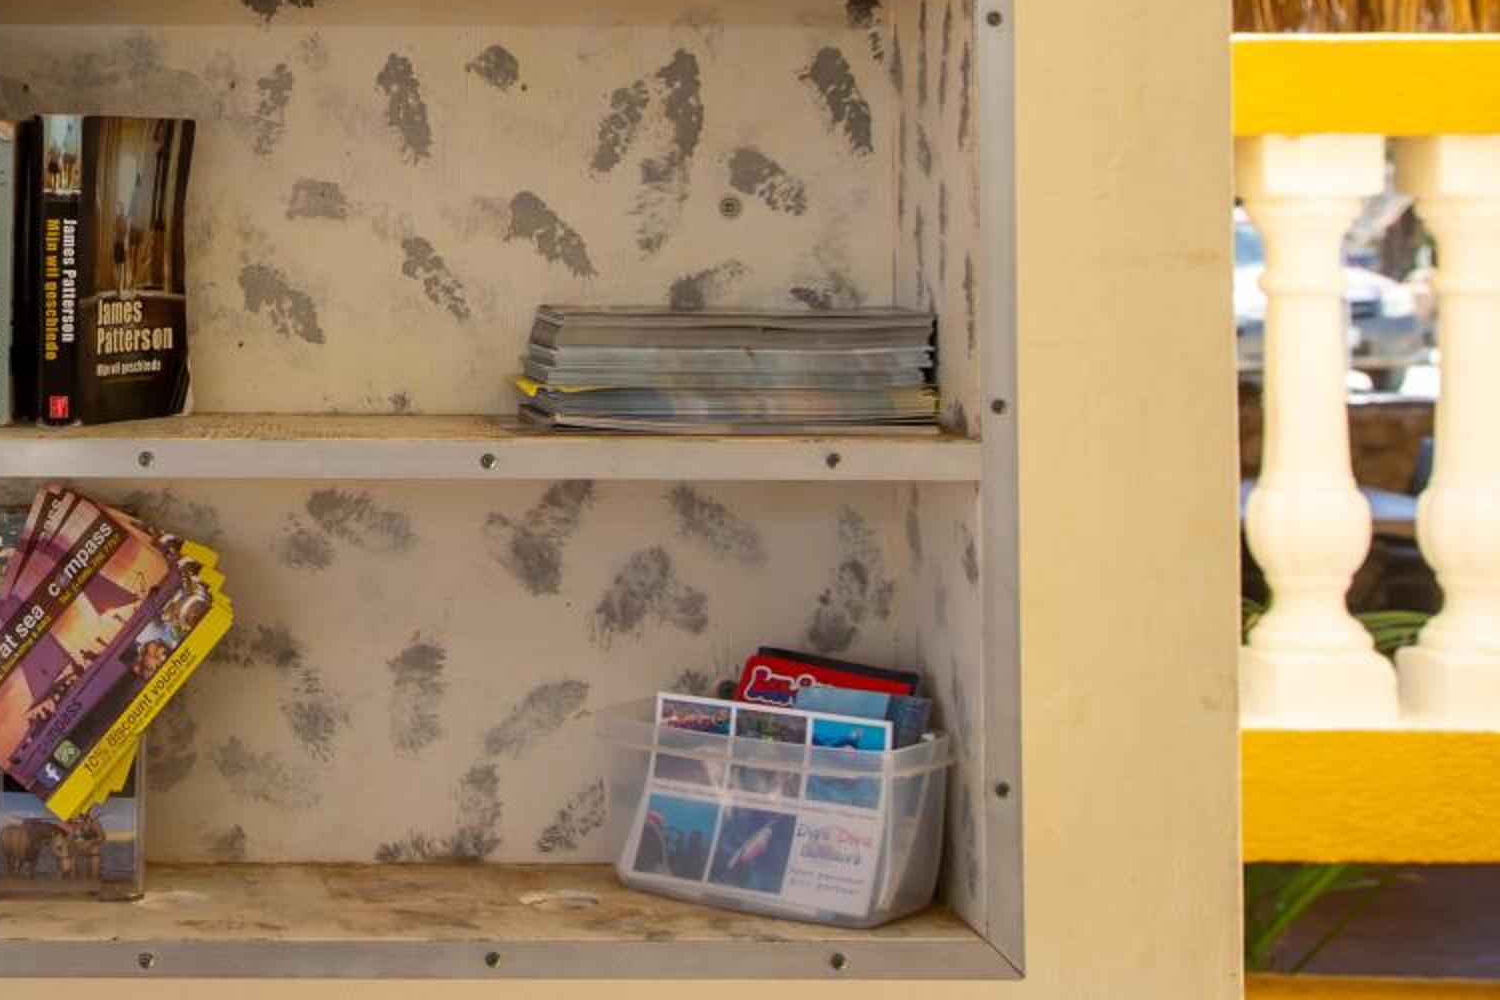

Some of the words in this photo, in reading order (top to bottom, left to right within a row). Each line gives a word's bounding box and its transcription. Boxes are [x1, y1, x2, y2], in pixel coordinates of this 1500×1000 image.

[62, 218, 78, 266] James
[45, 254, 60, 279] wil
[44, 281, 59, 361] geschiede
[60, 268, 77, 342] Patterson
[98, 299, 143, 326] James
[96, 326, 174, 354] Patterson
[15, 604, 46, 640] sea
[105, 694, 154, 748] discount
[149, 646, 193, 697] voucher
